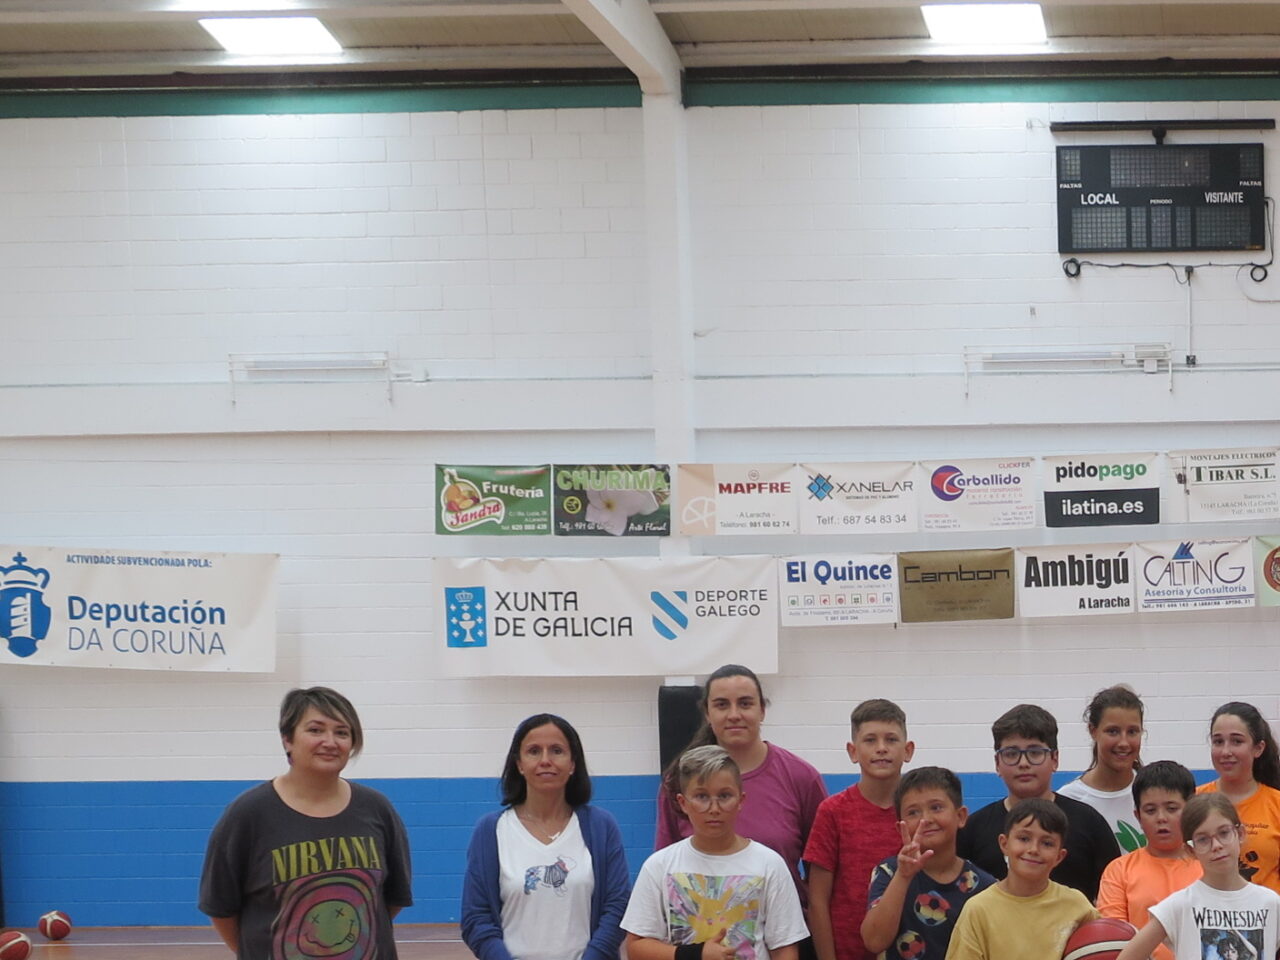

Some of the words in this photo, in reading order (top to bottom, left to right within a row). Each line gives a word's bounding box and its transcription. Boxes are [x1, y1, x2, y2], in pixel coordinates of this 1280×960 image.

[1081, 193, 1119, 205] LOCAL
[1204, 192, 1243, 203] VISITANTE
[1190, 453, 1229, 461] MONTAJES
[557, 469, 667, 490] CHURIMA
[1055, 461, 1147, 483] pidopago
[1190, 466, 1245, 482] TIBAR
[1250, 467, 1276, 479] S.L.
[719, 482, 791, 494] MAPFRE
[836, 481, 913, 493] XANELAR
[449, 503, 502, 525] Sandra
[1062, 499, 1144, 515] ilatina.es
[843, 515, 862, 525] 687
[864, 515, 876, 524] 54
[880, 515, 892, 524] 83
[895, 514, 907, 523] 34
[67, 555, 116, 565] ACTIVIDADE
[117, 556, 186, 567] SUBVENCIONADA
[187, 559, 212, 568] POLA:
[1024, 551, 1129, 589] Ambigú
[1144, 552, 1245, 586] CALTING
[787, 561, 807, 583] El
[813, 560, 892, 585] Quince
[904, 565, 1010, 584] Cambon
[695, 589, 768, 602] DEPORTE
[1145, 588, 1184, 596] Asesoría
[1194, 584, 1247, 595] Consultoría
[495, 591, 578, 612] XUNTA
[1079, 599, 1086, 609] A
[1088, 596, 1130, 609] Laracha
[67, 595, 226, 628] Deputación
[695, 604, 761, 617] GALEGO
[495, 617, 526, 637] DE
[533, 616, 633, 637] GALICIA
[68, 627, 104, 651] DA
[112, 627, 226, 655] CORUÑA
[271, 836, 382, 885] NIRVANA
[1192, 907, 1269, 928] WEDNESDAY
